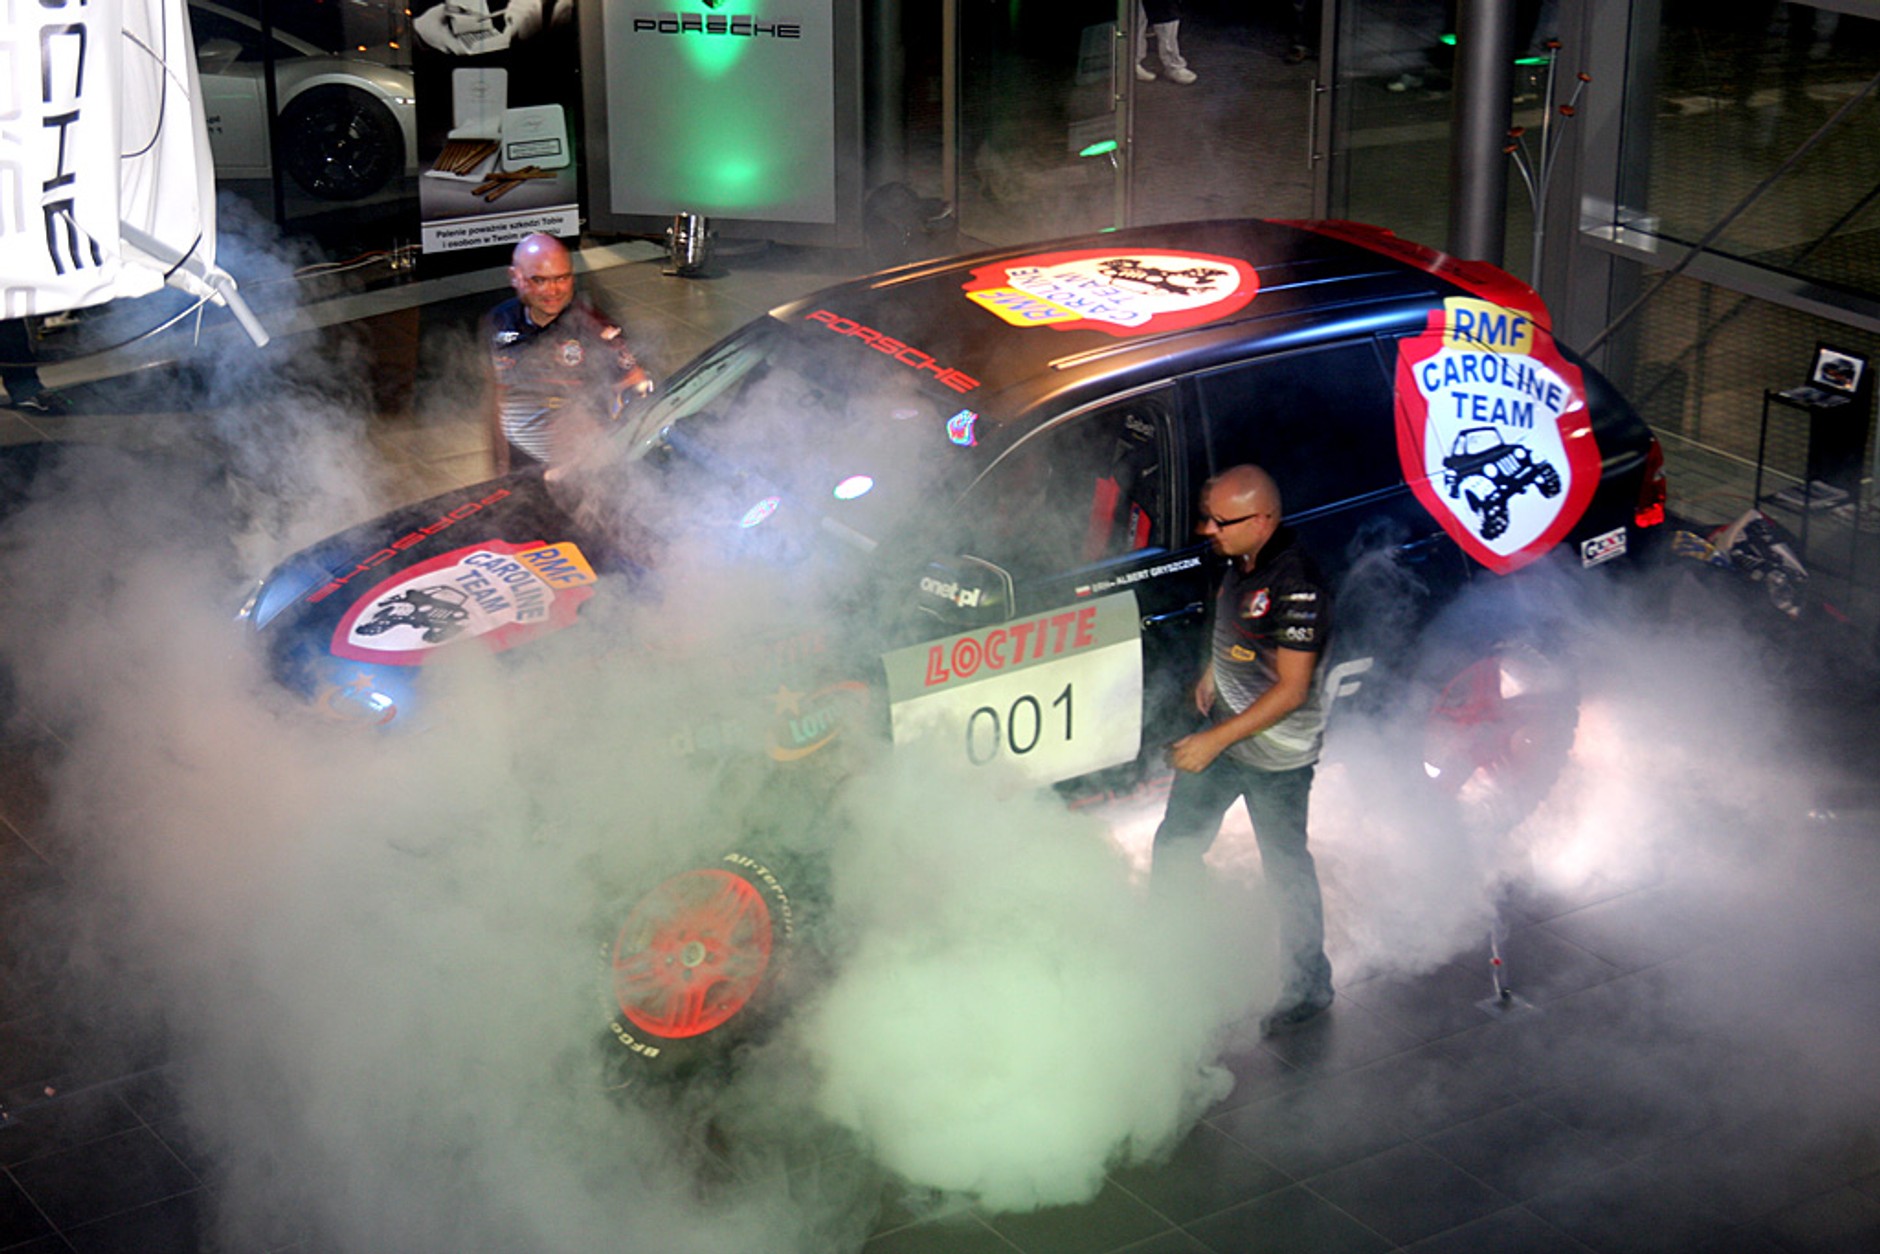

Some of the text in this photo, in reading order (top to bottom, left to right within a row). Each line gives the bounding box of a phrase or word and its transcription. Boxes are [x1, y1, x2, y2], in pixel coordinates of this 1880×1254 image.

[633, 19, 800, 38] PORSCHE
[979, 291, 1070, 321] RMF
[1010, 267, 1137, 321] CAROLINE
[1055, 272, 1131, 305] TEAM
[1453, 308, 1527, 347] RMF
[804, 309, 982, 394] PORSCHE
[1422, 354, 1562, 414] CAROLINE
[1451, 391, 1534, 429] TEAM
[306, 489, 511, 603] PORSCHE
[523, 547, 588, 584] RMF
[456, 570, 511, 614] TEAM
[464, 553, 546, 621] CAROLINE
[920, 575, 980, 607] onet.pl
[924, 606, 1098, 688] LOCTITE
[966, 682, 1073, 766] 001
